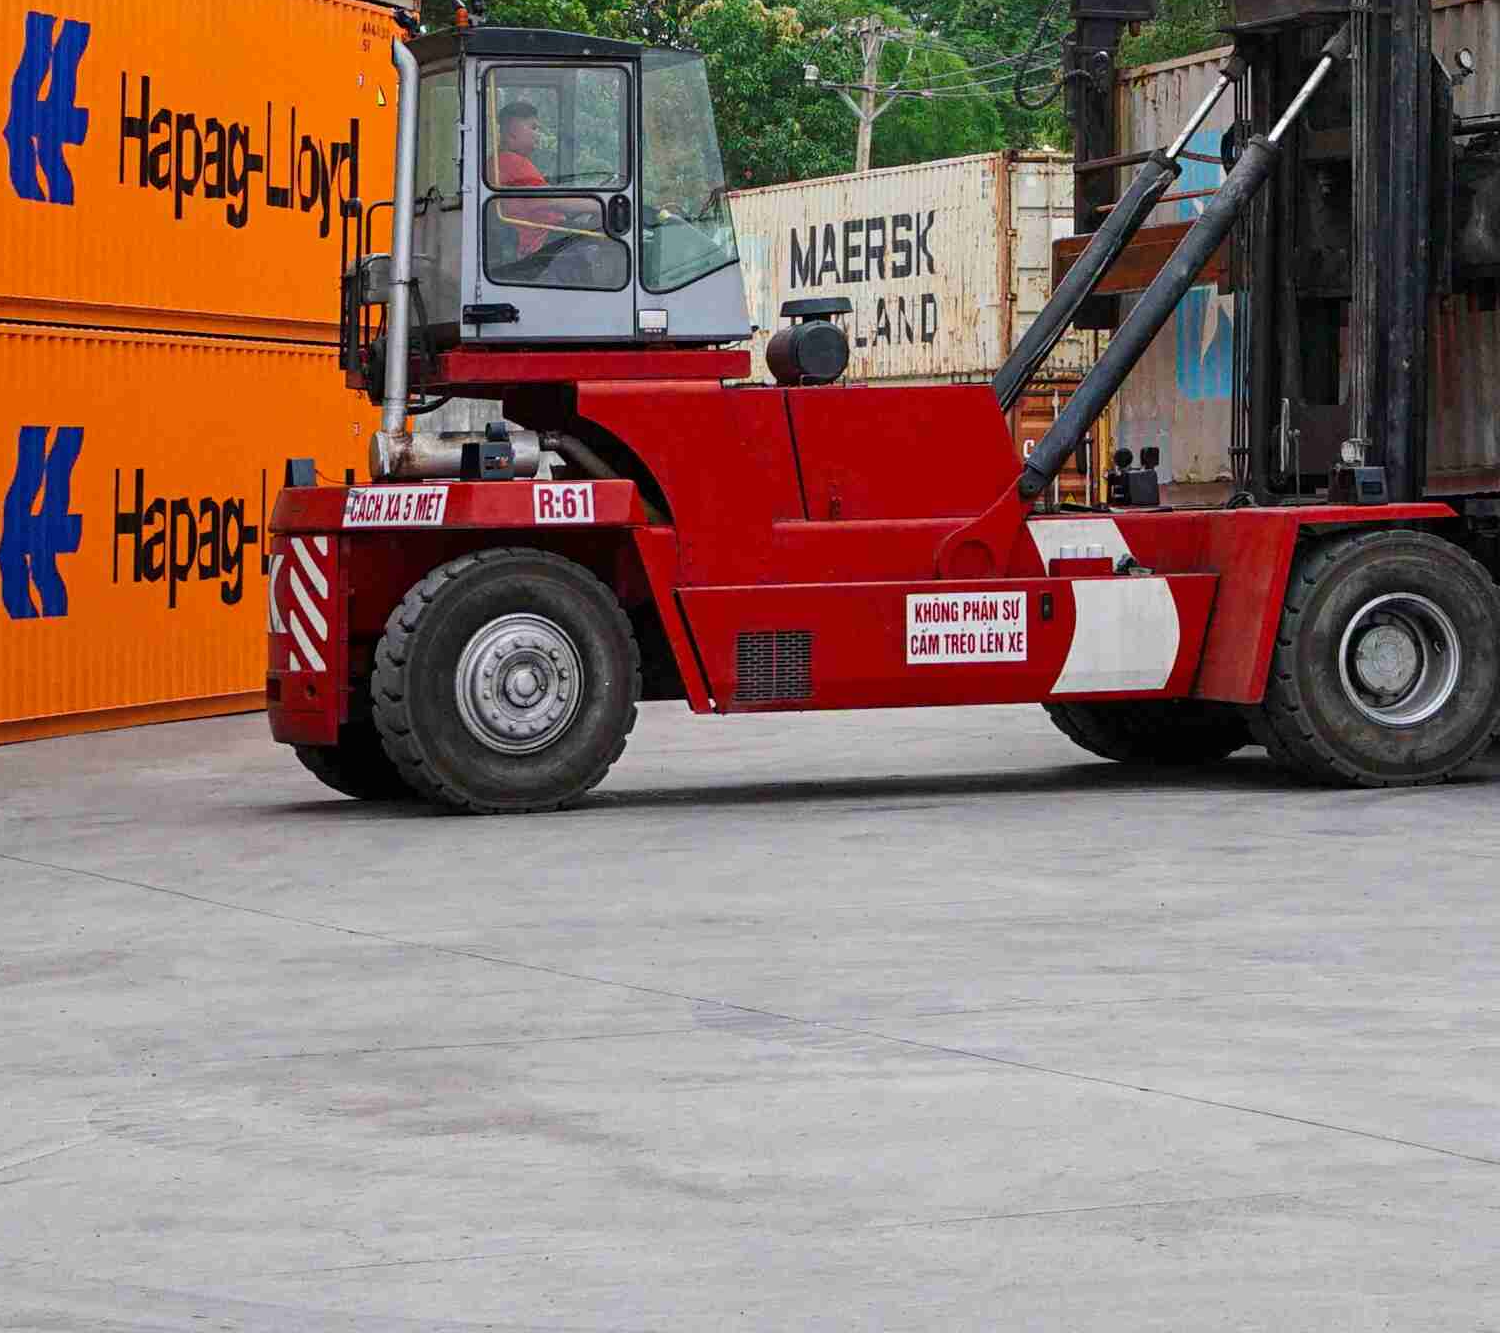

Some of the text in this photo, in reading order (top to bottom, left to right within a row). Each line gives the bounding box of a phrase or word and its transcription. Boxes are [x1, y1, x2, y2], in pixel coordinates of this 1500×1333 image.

[119, 71, 360, 238] Hapag-Lloyd
[790, 210, 936, 289] MAERSK
[386, 493, 401, 523] XA
[403, 493, 412, 522] 5
[413, 488, 444, 522] MÉT
[538, 488, 590, 520] R:61
[915, 597, 959, 623] KHÔNG
[1008, 632, 1024, 653] XE
